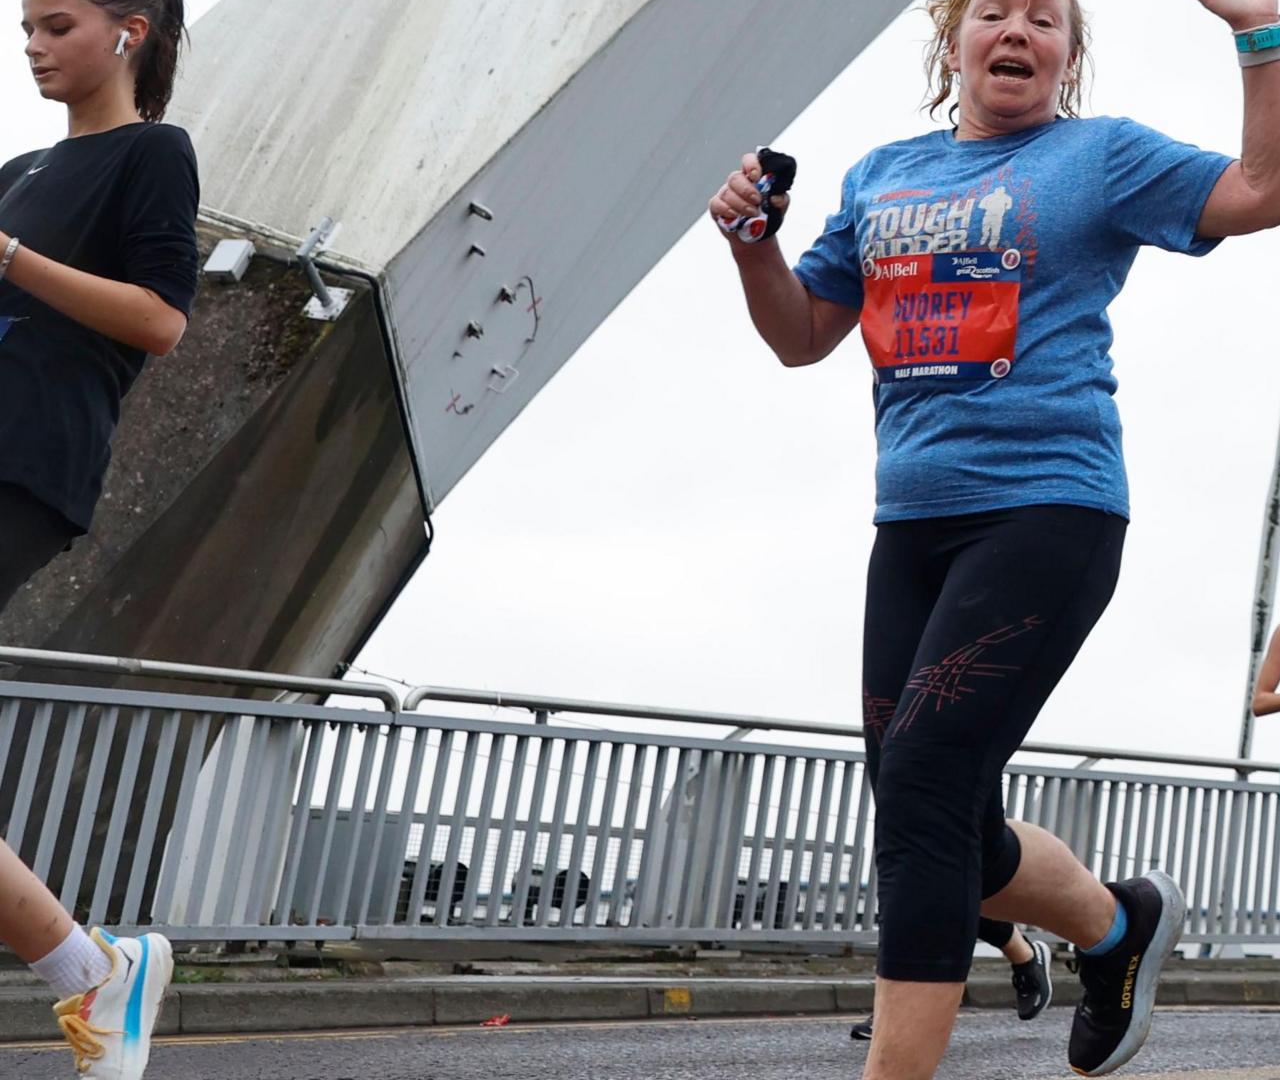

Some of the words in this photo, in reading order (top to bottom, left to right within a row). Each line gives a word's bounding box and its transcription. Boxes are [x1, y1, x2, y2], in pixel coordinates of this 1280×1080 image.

[868, 198, 975, 243] TOUGH
[882, 262, 918, 280] AJBell
[895, 291, 973, 323] AUDREY
[895, 325, 960, 358] 11531
[895, 367, 911, 379] HALF
[912, 365, 958, 377] MARATHON
